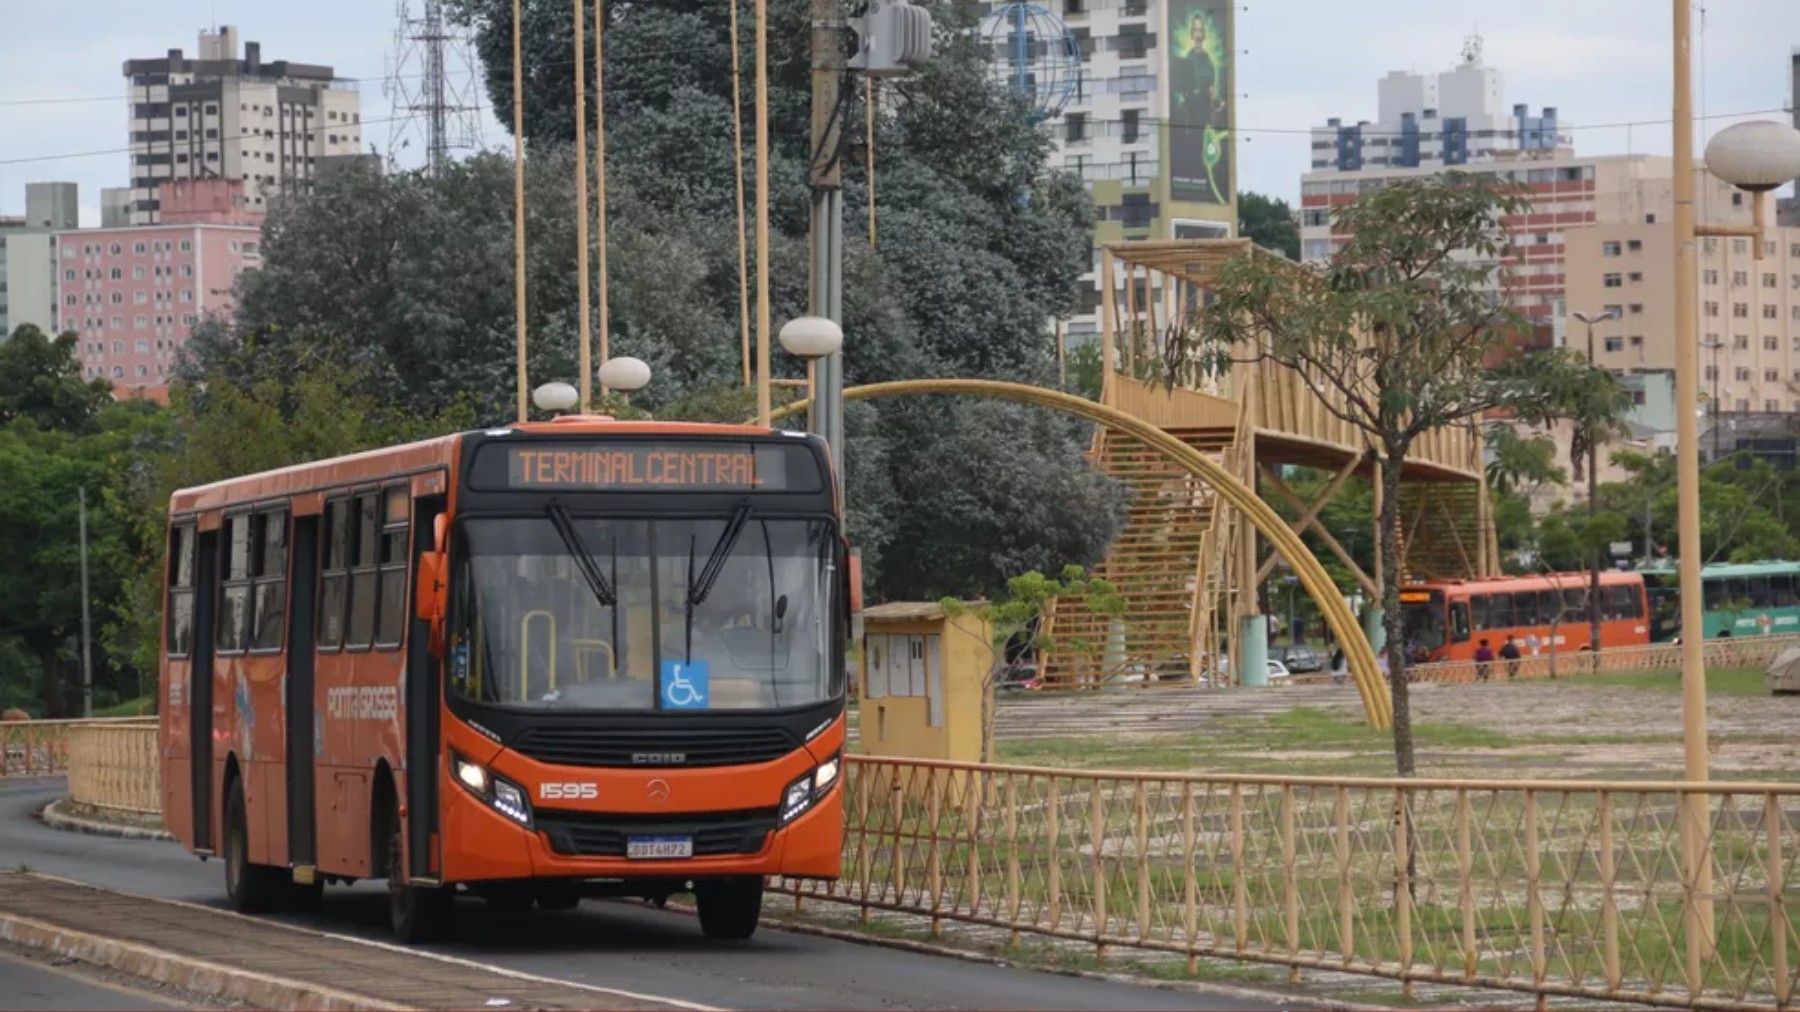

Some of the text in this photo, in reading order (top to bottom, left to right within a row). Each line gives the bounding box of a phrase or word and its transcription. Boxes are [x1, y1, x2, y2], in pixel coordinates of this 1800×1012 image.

[519, 451, 764, 484] TERMINAL CENTRAL
[540, 783, 598, 798] 1595
